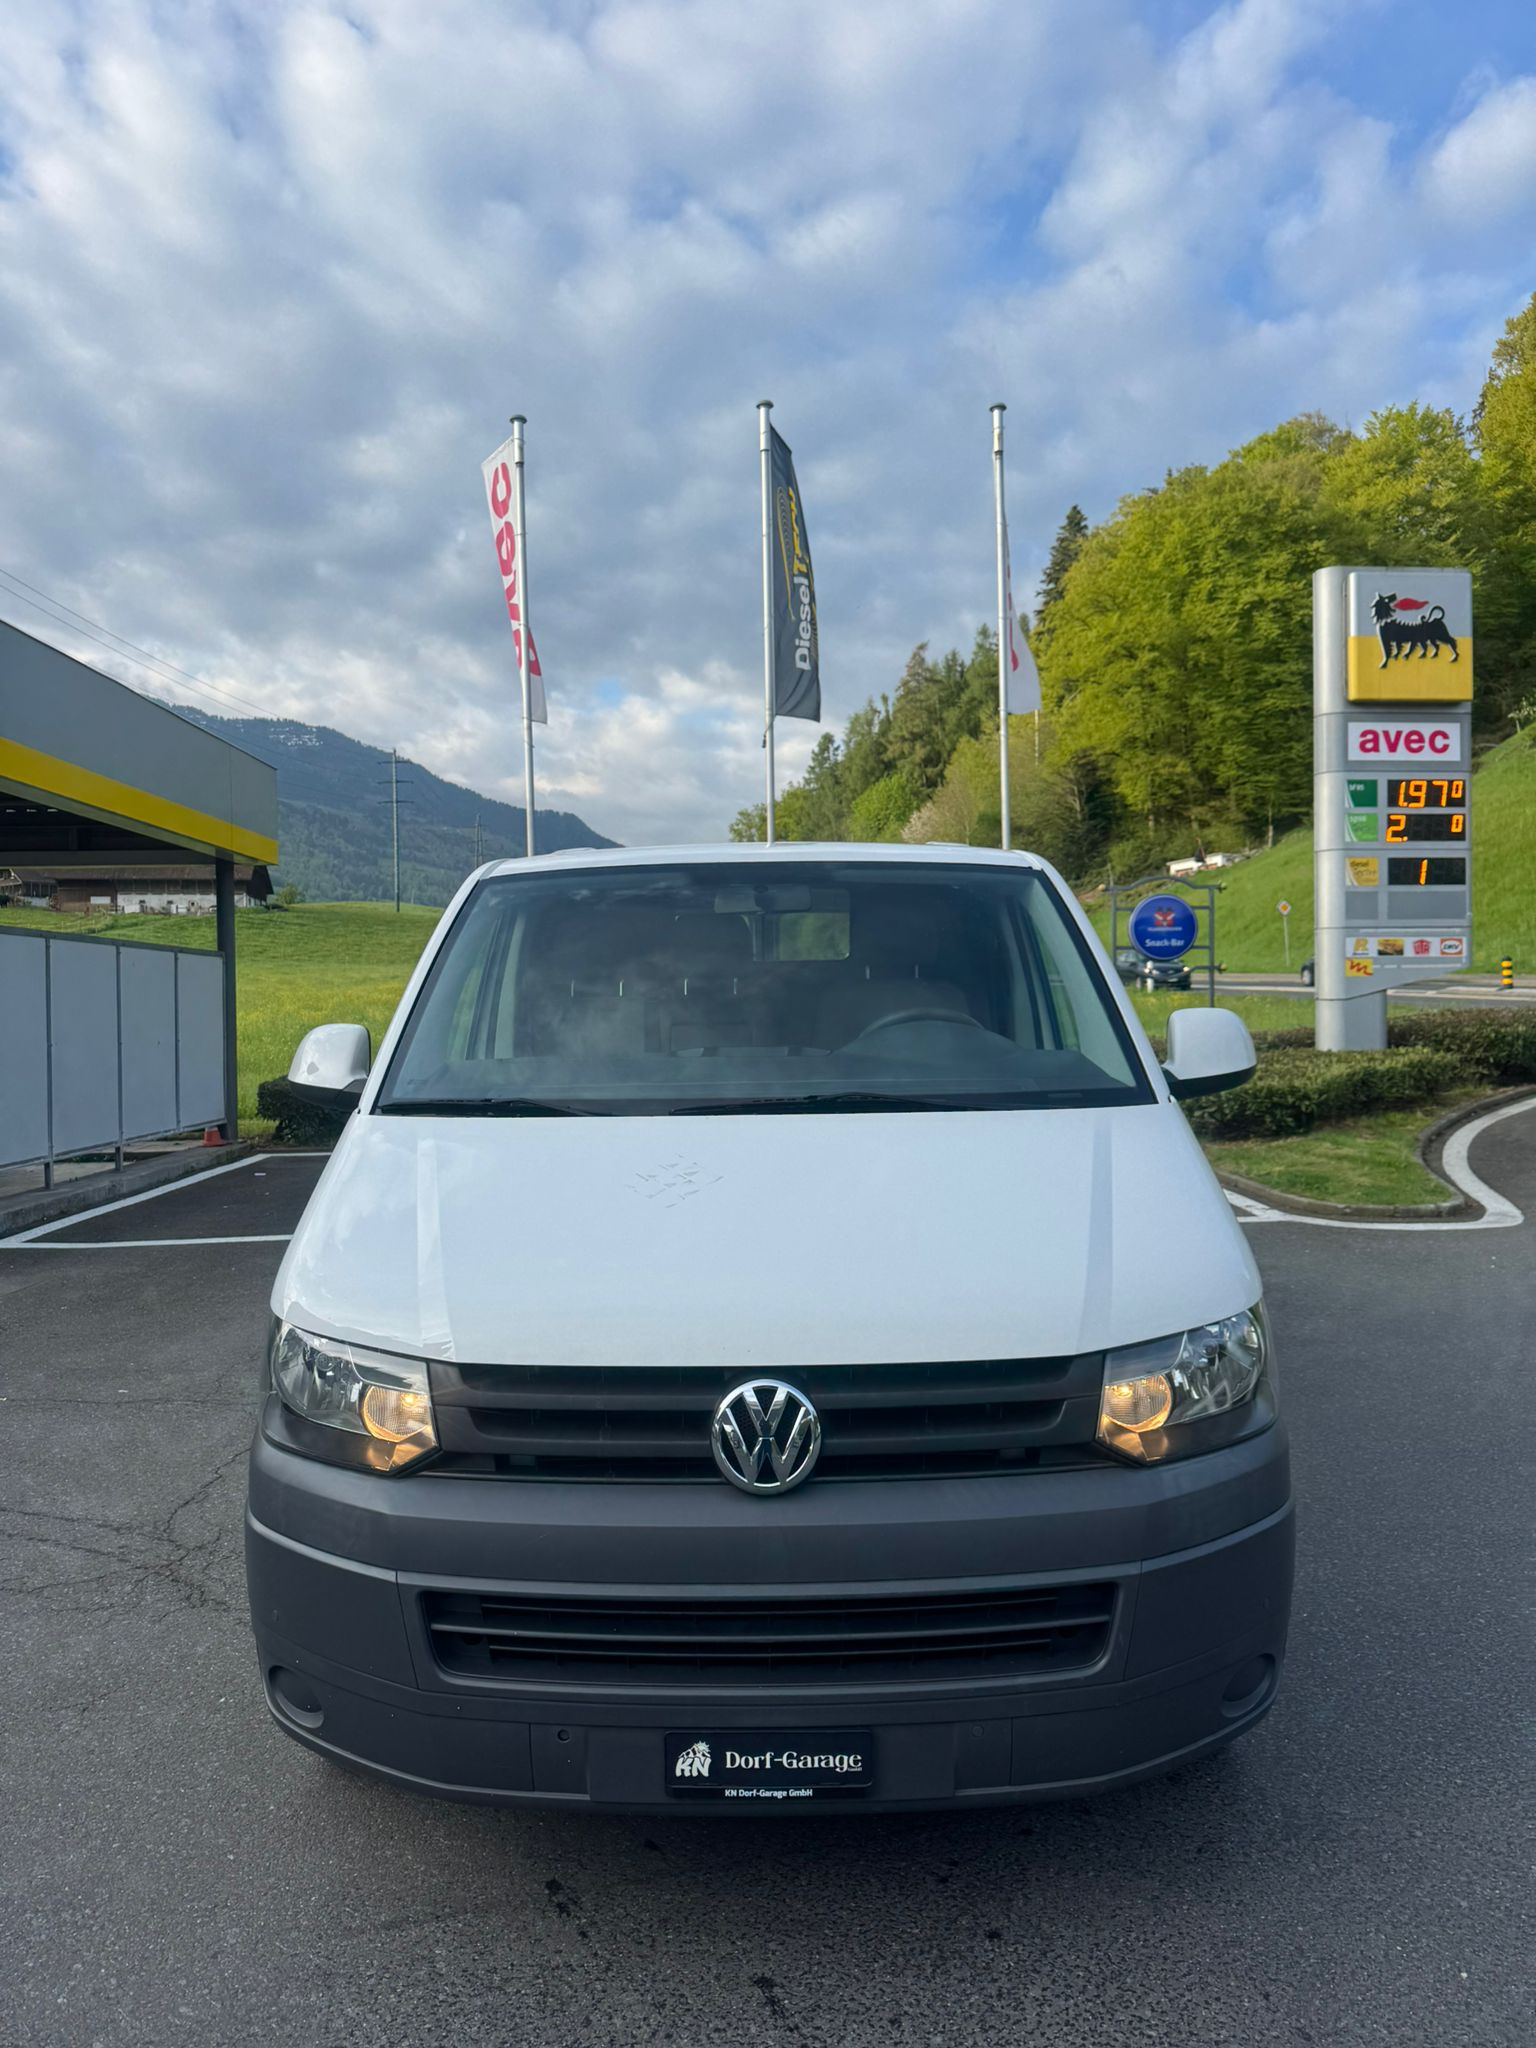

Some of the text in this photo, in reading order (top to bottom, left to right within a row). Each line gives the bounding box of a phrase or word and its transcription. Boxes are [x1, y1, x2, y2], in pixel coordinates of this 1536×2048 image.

[1358, 729, 1450, 754] avec
[1144, 938, 1185, 948] Snack-Bar
[725, 1751, 862, 1772] Dorf-Garage
[724, 1788, 813, 1798] KN Dorf-Garage GmbH
